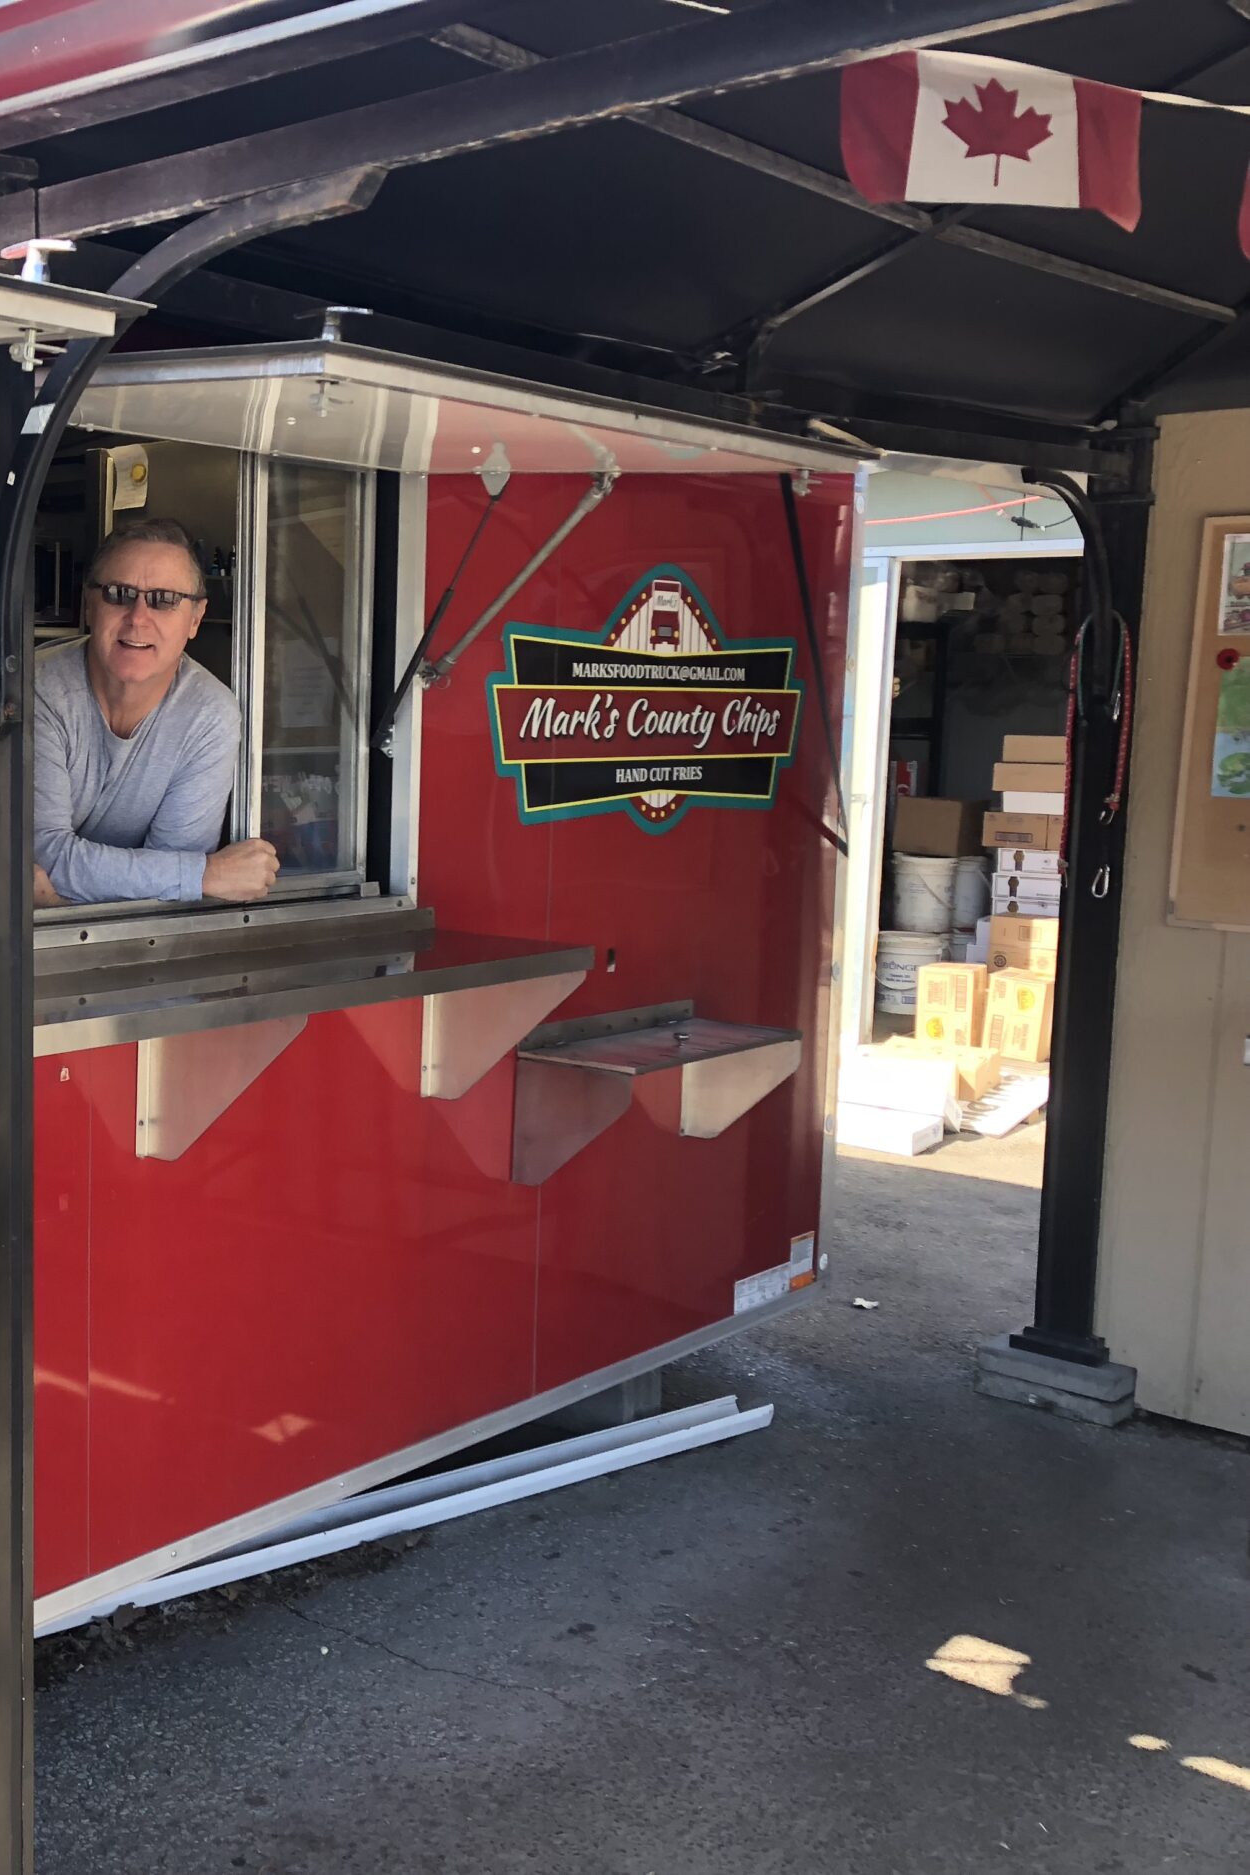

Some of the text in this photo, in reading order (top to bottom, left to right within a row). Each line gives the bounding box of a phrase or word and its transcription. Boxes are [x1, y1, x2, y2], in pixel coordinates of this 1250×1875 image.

[572, 662, 746, 682] MARKSFOODTRUCK@GMAIL.COM
[519, 694, 781, 749] Mark's County Chips
[615, 766, 703, 783] HAND CUT FRIES
